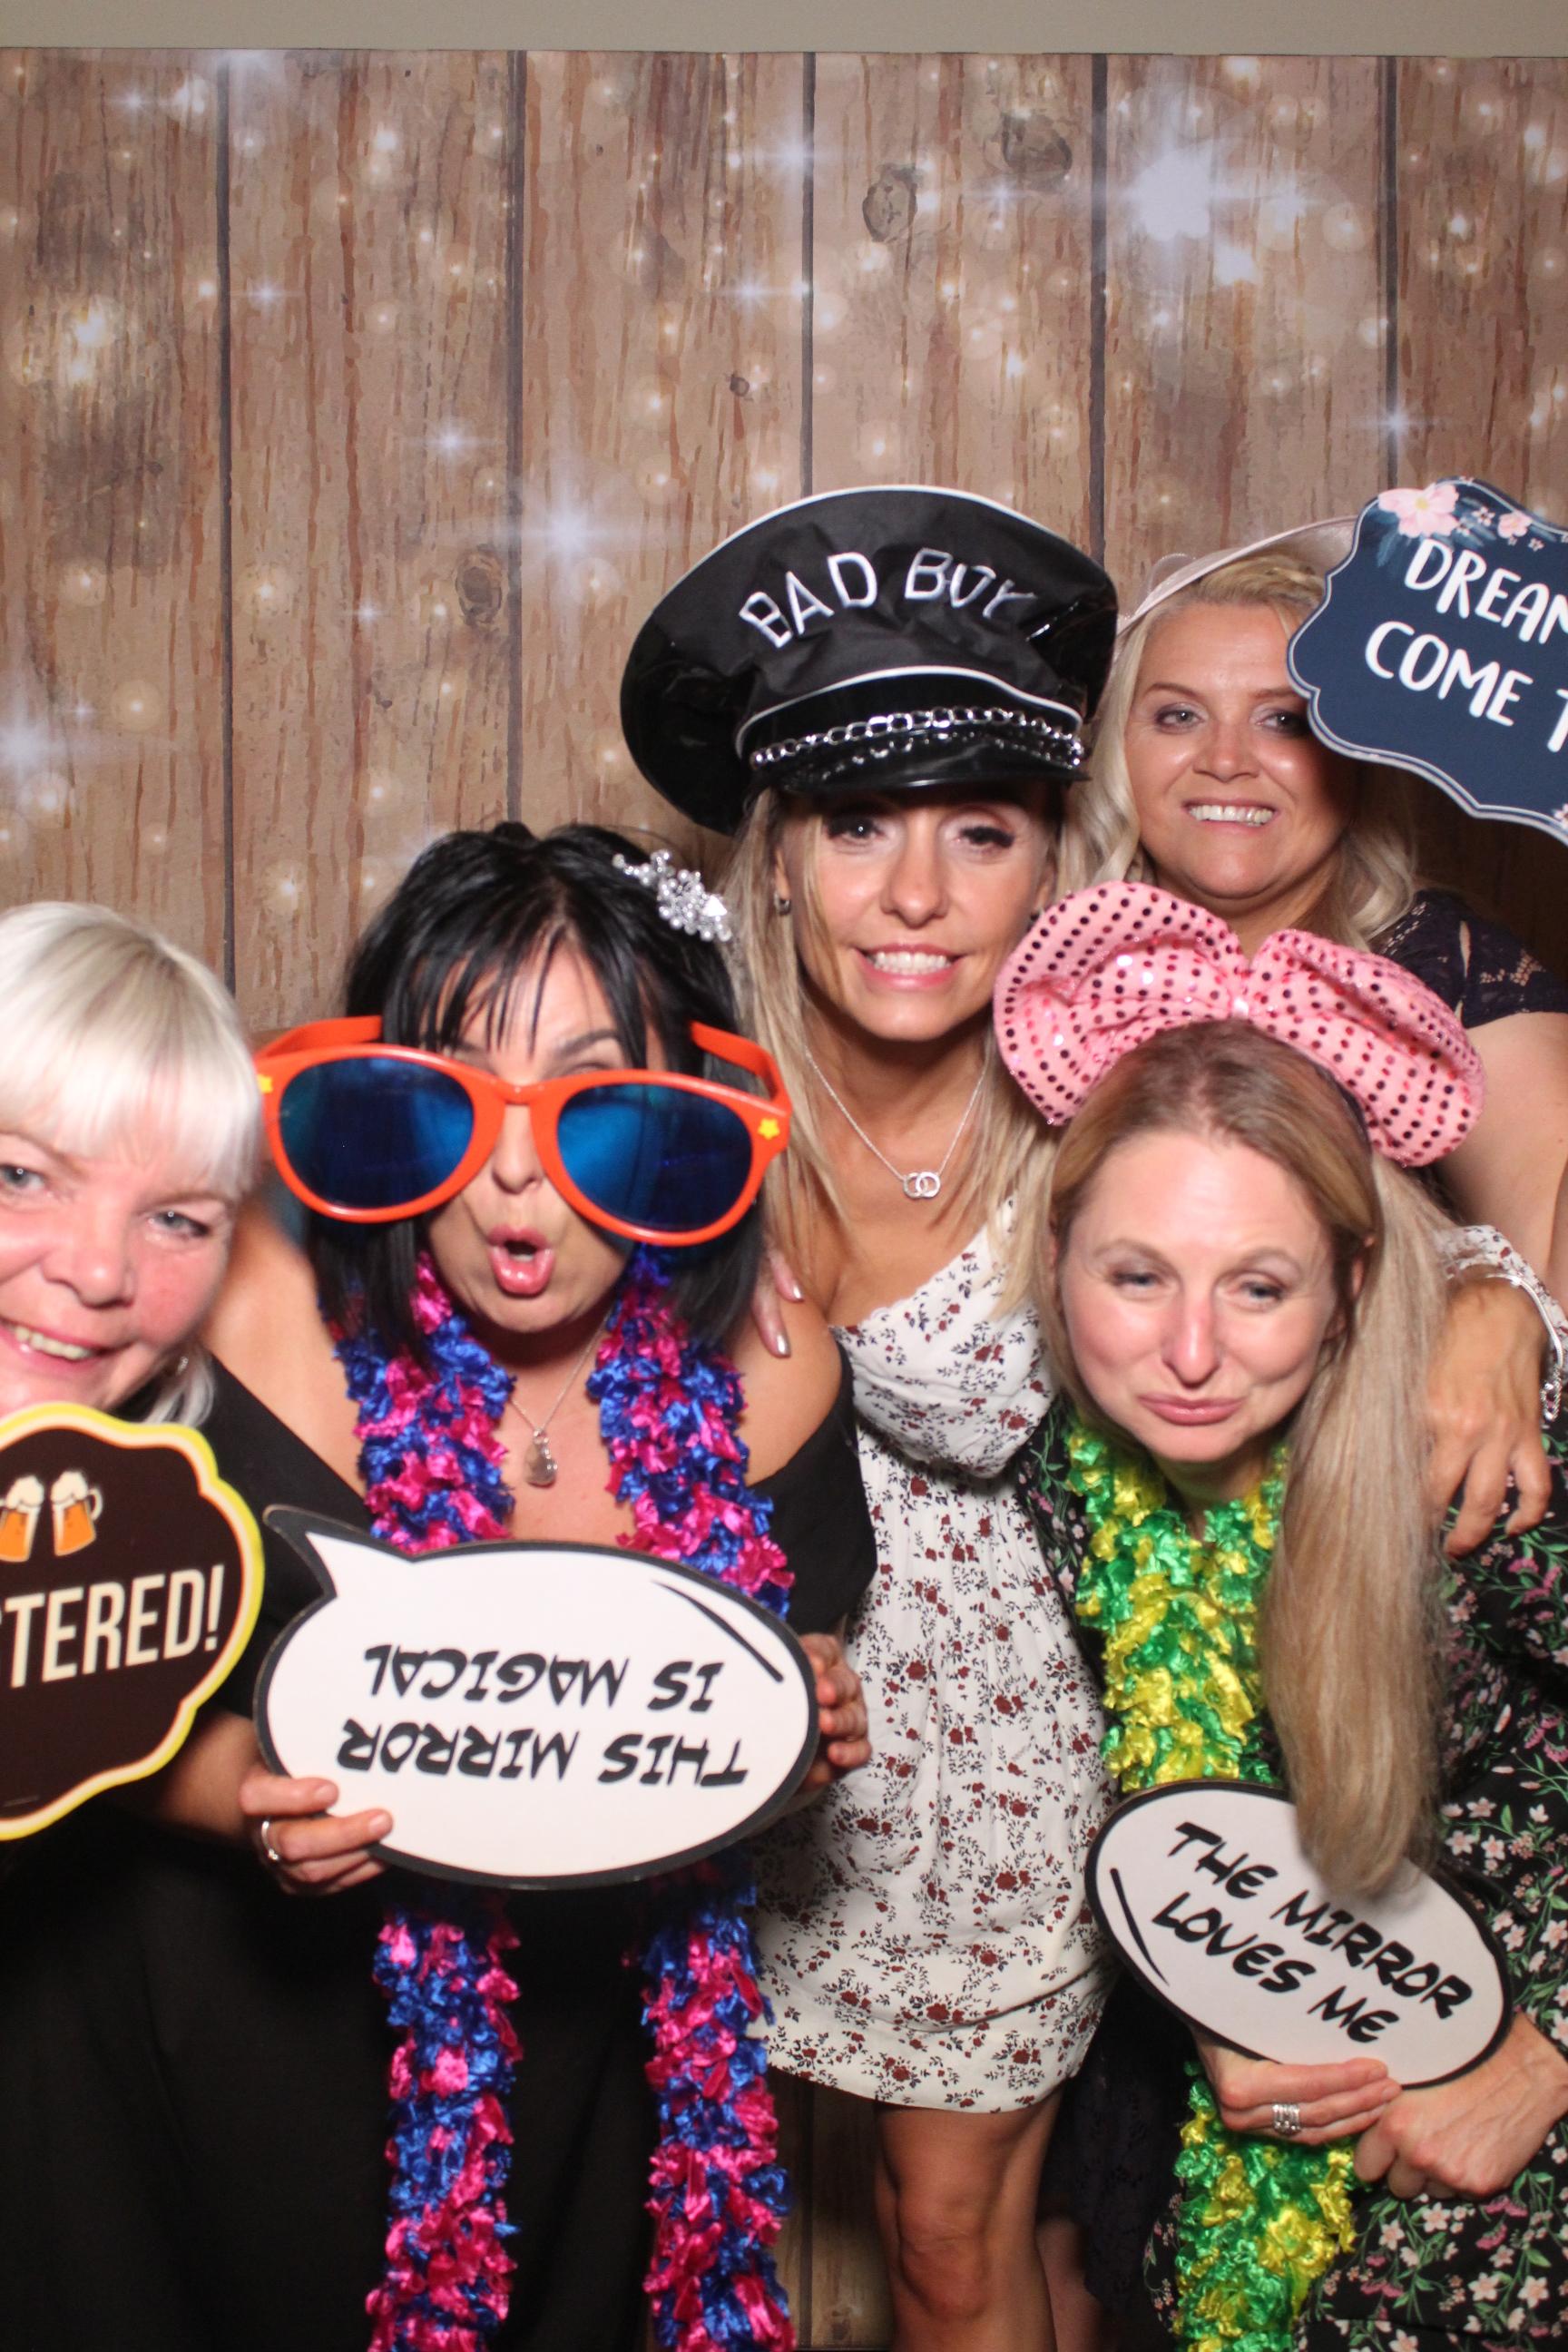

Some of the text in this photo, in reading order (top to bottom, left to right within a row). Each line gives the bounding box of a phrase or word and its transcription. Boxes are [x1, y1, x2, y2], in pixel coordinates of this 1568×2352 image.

[739, 546, 1034, 648] BAD BOY
[1365, 621, 1534, 727] COME
[0, 1563, 225, 1688] TERED!
[365, 1644, 724, 1712] IS MAGICAL
[336, 1719, 749, 1788] THIS MIRROR
[1152, 1891, 1400, 2043] LOVES ME
[1167, 1821, 1473, 2020] THE MIRROR
